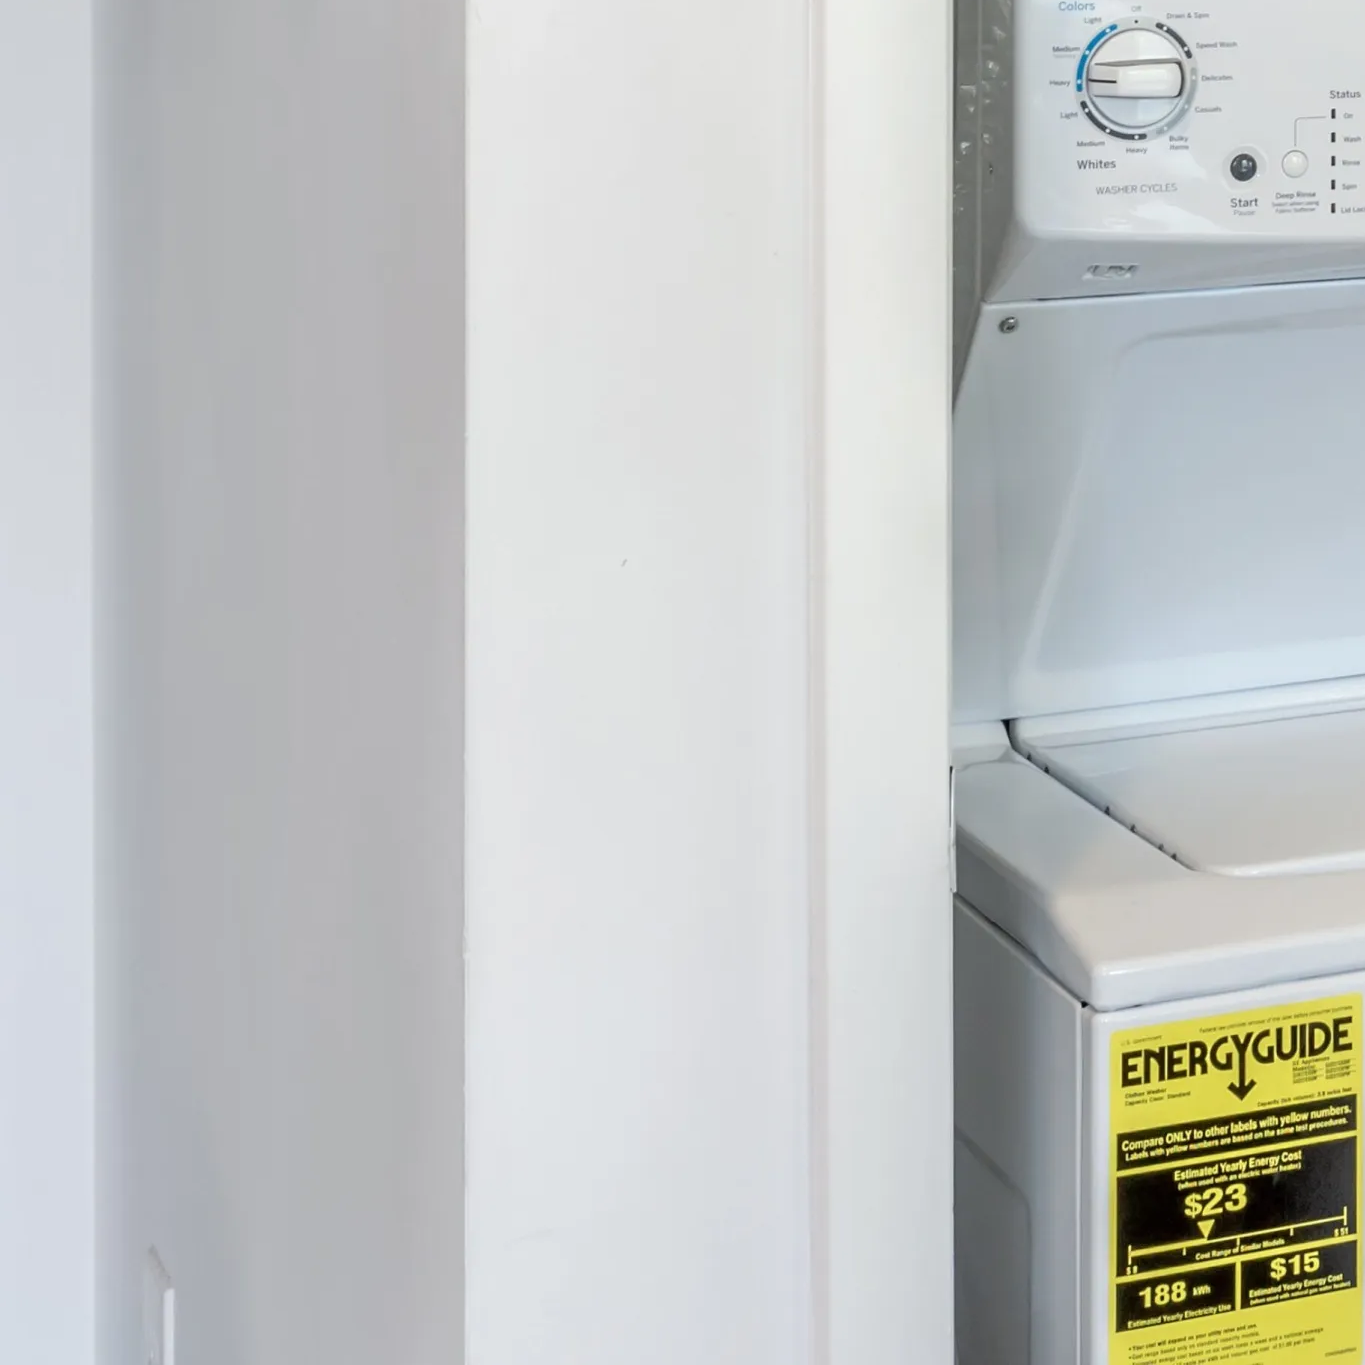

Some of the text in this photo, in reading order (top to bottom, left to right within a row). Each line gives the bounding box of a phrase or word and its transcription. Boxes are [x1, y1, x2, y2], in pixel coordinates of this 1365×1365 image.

[1058, 1, 1095, 12] Colors
[1329, 90, 1362, 100] Status
[1126, 146, 1148, 154] Heavy
[1077, 158, 1116, 170] Whites
[1096, 183, 1178, 196] WASHER CYCLES
[1230, 197, 1258, 208] Start
[1122, 1016, 1353, 1088] ENERGYGUIDE
[1122, 1105, 1352, 1152] Compare ONLY to other labels with yellow numbers.
[1125, 1151, 1149, 1162] Labels
[1150, 1147, 1165, 1156] with
[1166, 1144, 1188, 1156] yellow
[1189, 1140, 1219, 1150] numbers
[1220, 1137, 1231, 1146] are
[1232, 1132, 1252, 1143] based
[1254, 1132, 1263, 1140] on
[1264, 1129, 1275, 1138] the
[1276, 1126, 1294, 1136] same
[1296, 1123, 1308, 1132] test
[1174, 1150, 1302, 1182] Estimated Yearly Energy Cost
[1184, 1183, 1248, 1218] $23
[1195, 1238, 1285, 1260] Cost Range of Similar Models
[1270, 1251, 1320, 1281] $15
[1139, 1281, 1211, 1308] 188 kWh
[1249, 1274, 1343, 1298] Estimated Yearly Energy Cost
[1127, 1304, 1232, 1330] Estimated Yearly Electricity Use
